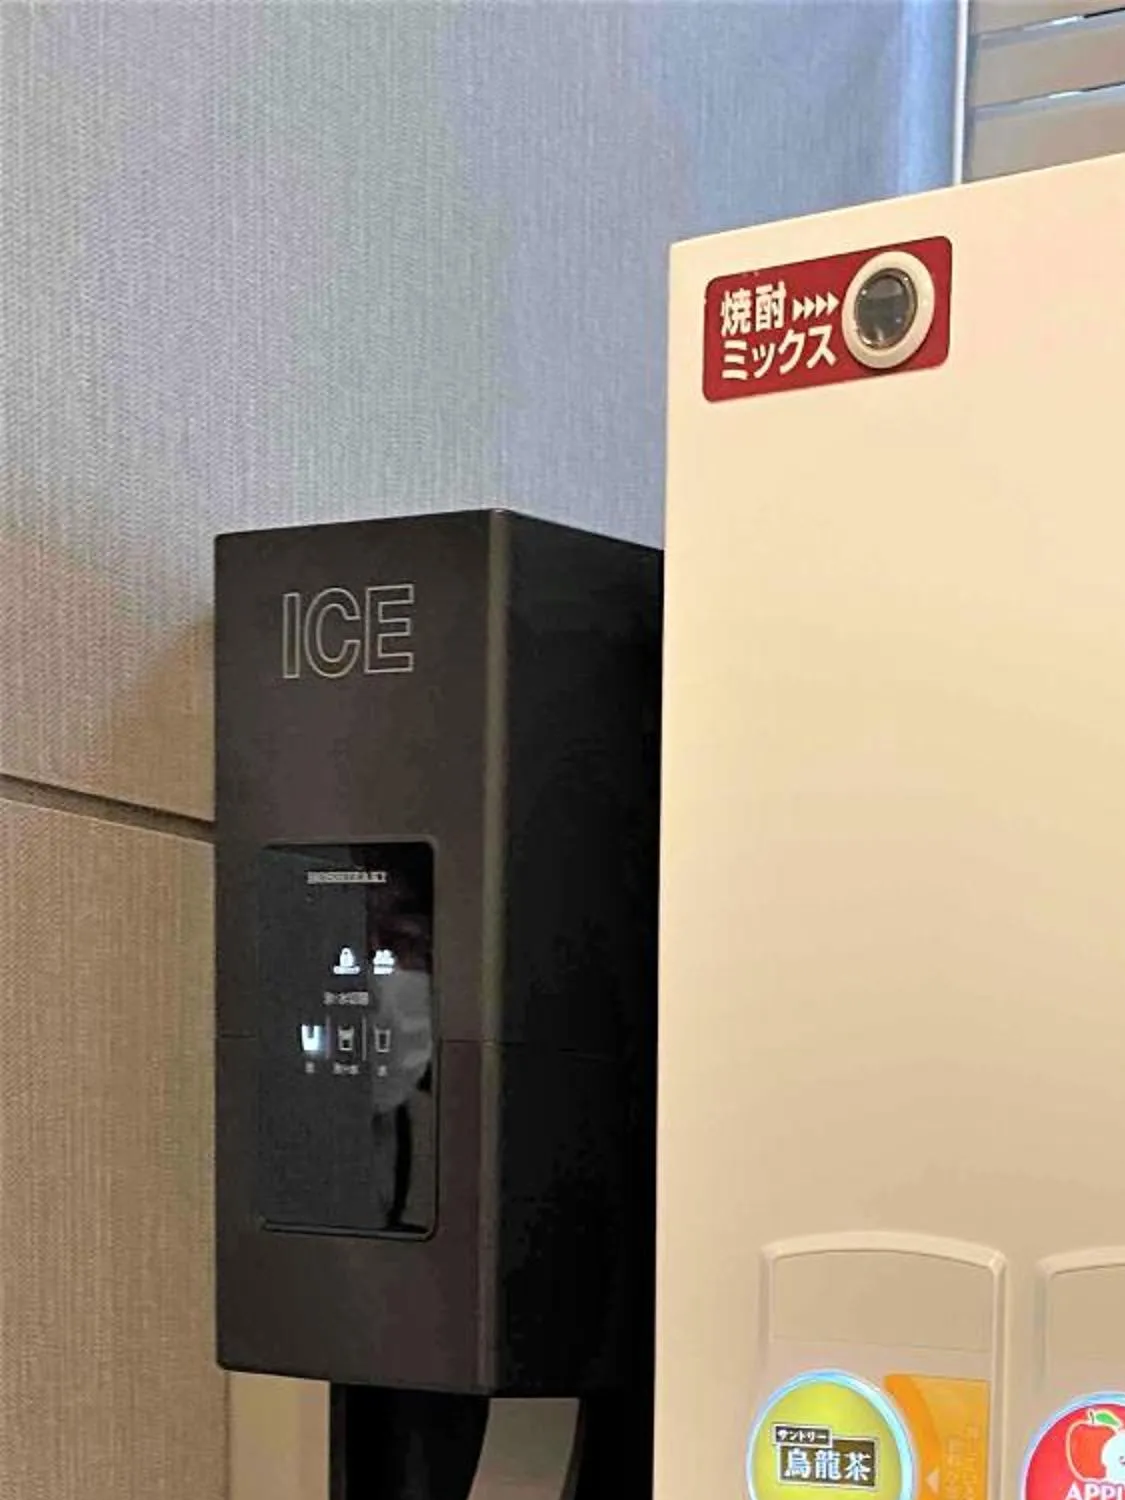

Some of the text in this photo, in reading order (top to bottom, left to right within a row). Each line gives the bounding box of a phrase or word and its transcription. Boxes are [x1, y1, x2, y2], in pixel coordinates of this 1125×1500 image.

[720, 281, 787, 336] 焼酎
[721, 324, 837, 381] ミックス
[282, 583, 415, 680] ICE
[777, 1428, 829, 1444] サントリー
